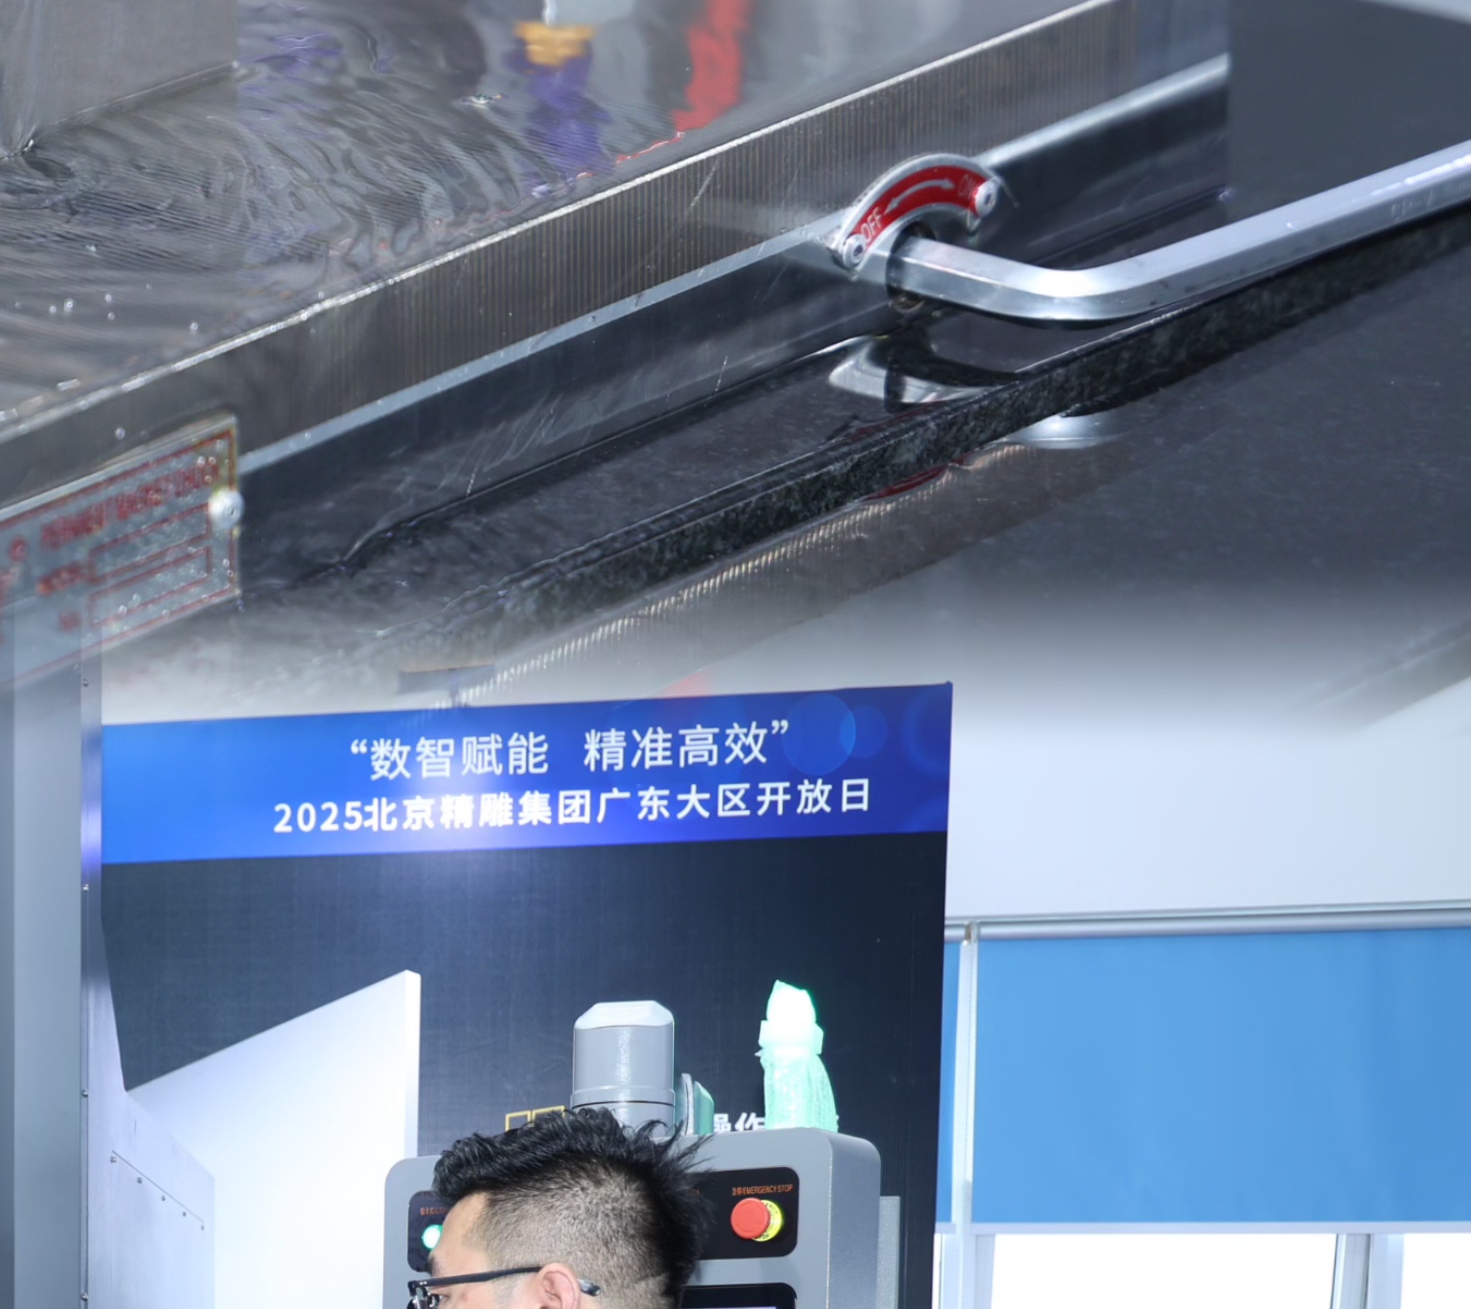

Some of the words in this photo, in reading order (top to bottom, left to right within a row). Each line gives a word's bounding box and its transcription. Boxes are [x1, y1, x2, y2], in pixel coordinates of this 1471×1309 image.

[860, 207, 884, 242] OFF
[350, 731, 549, 782] “数智赋能
[583, 719, 790, 772] 精准高效”
[273, 777, 871, 834] 2025北京精雕集团广东大区开放日
